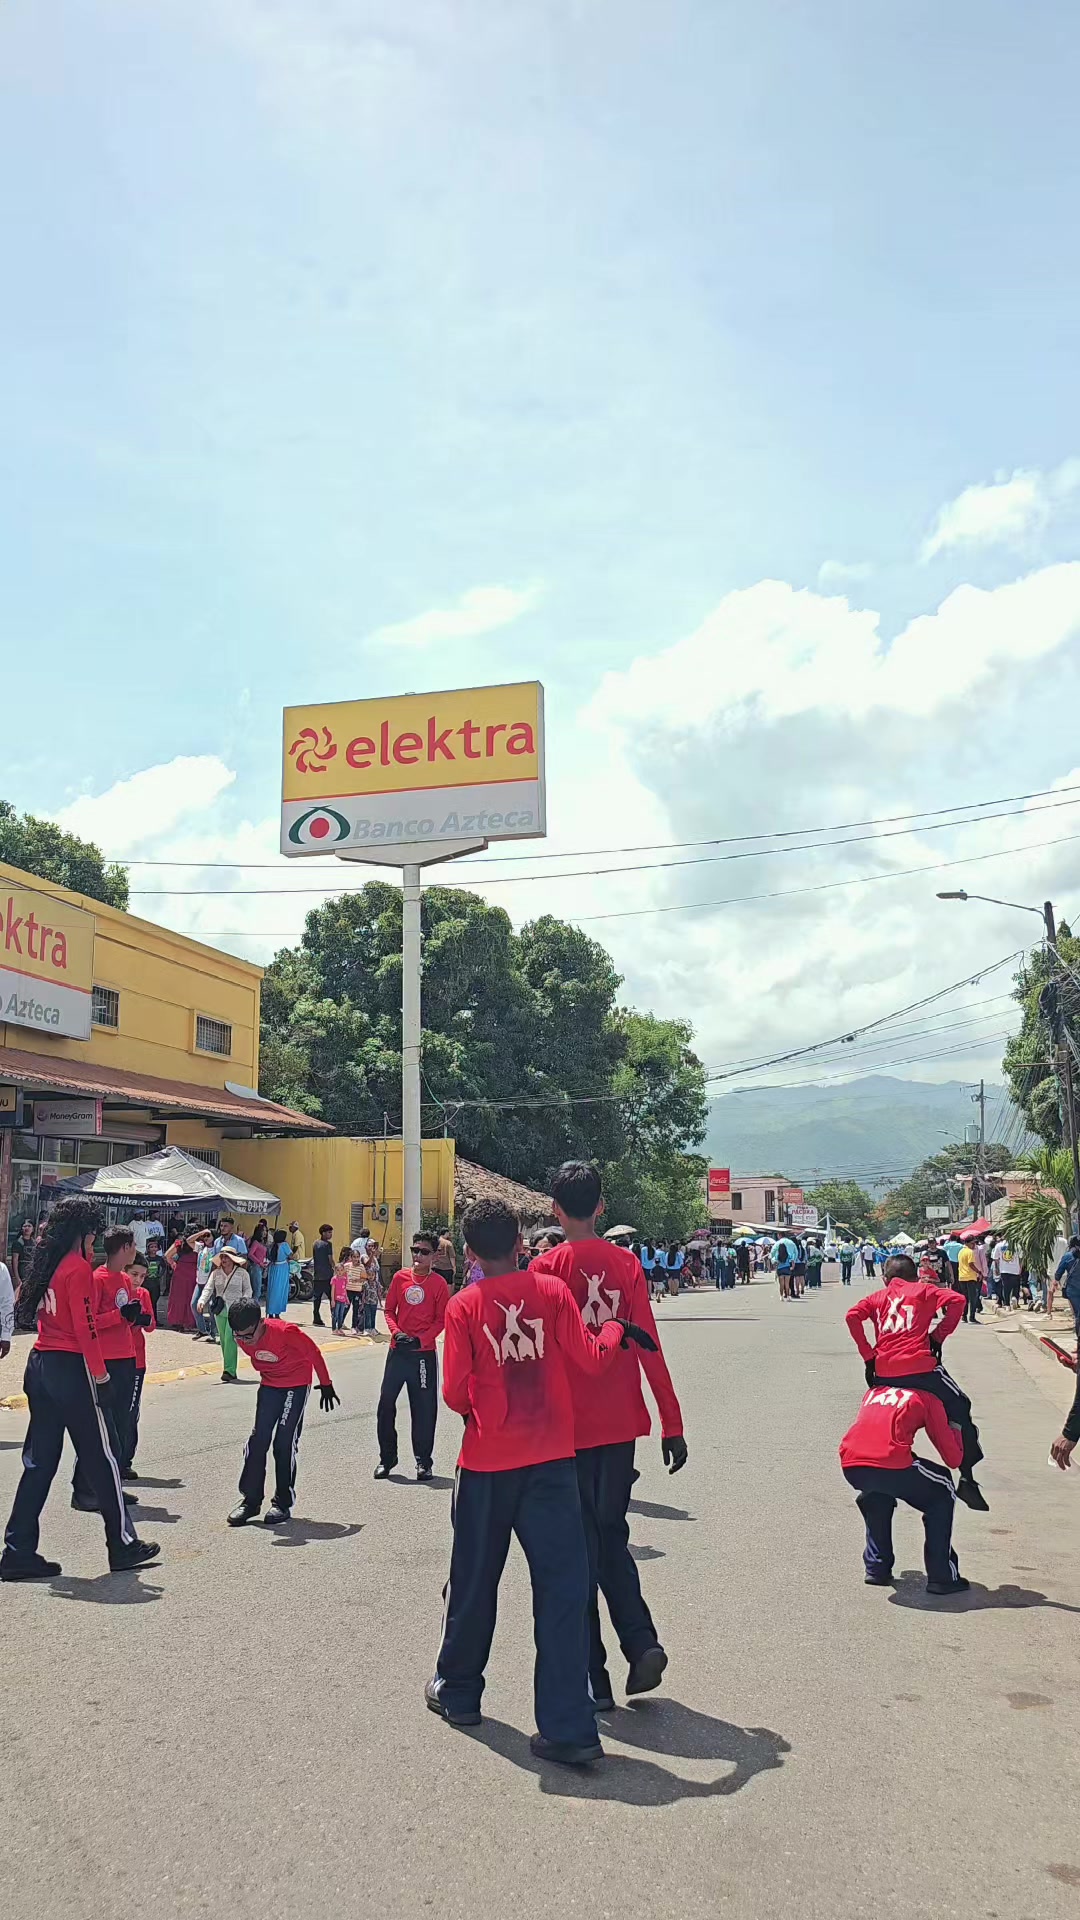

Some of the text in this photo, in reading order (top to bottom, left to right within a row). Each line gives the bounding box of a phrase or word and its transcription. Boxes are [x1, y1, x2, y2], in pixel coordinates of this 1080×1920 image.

[345, 716, 536, 769] elektra
[352, 808, 534, 840] Banco Azteca
[0, 896, 67, 970] ktra
[5, 993, 60, 1025] Azteca
[49, 1112, 93, 1121] MoneyGram
[280, 1390, 295, 1426] CEMGRA
